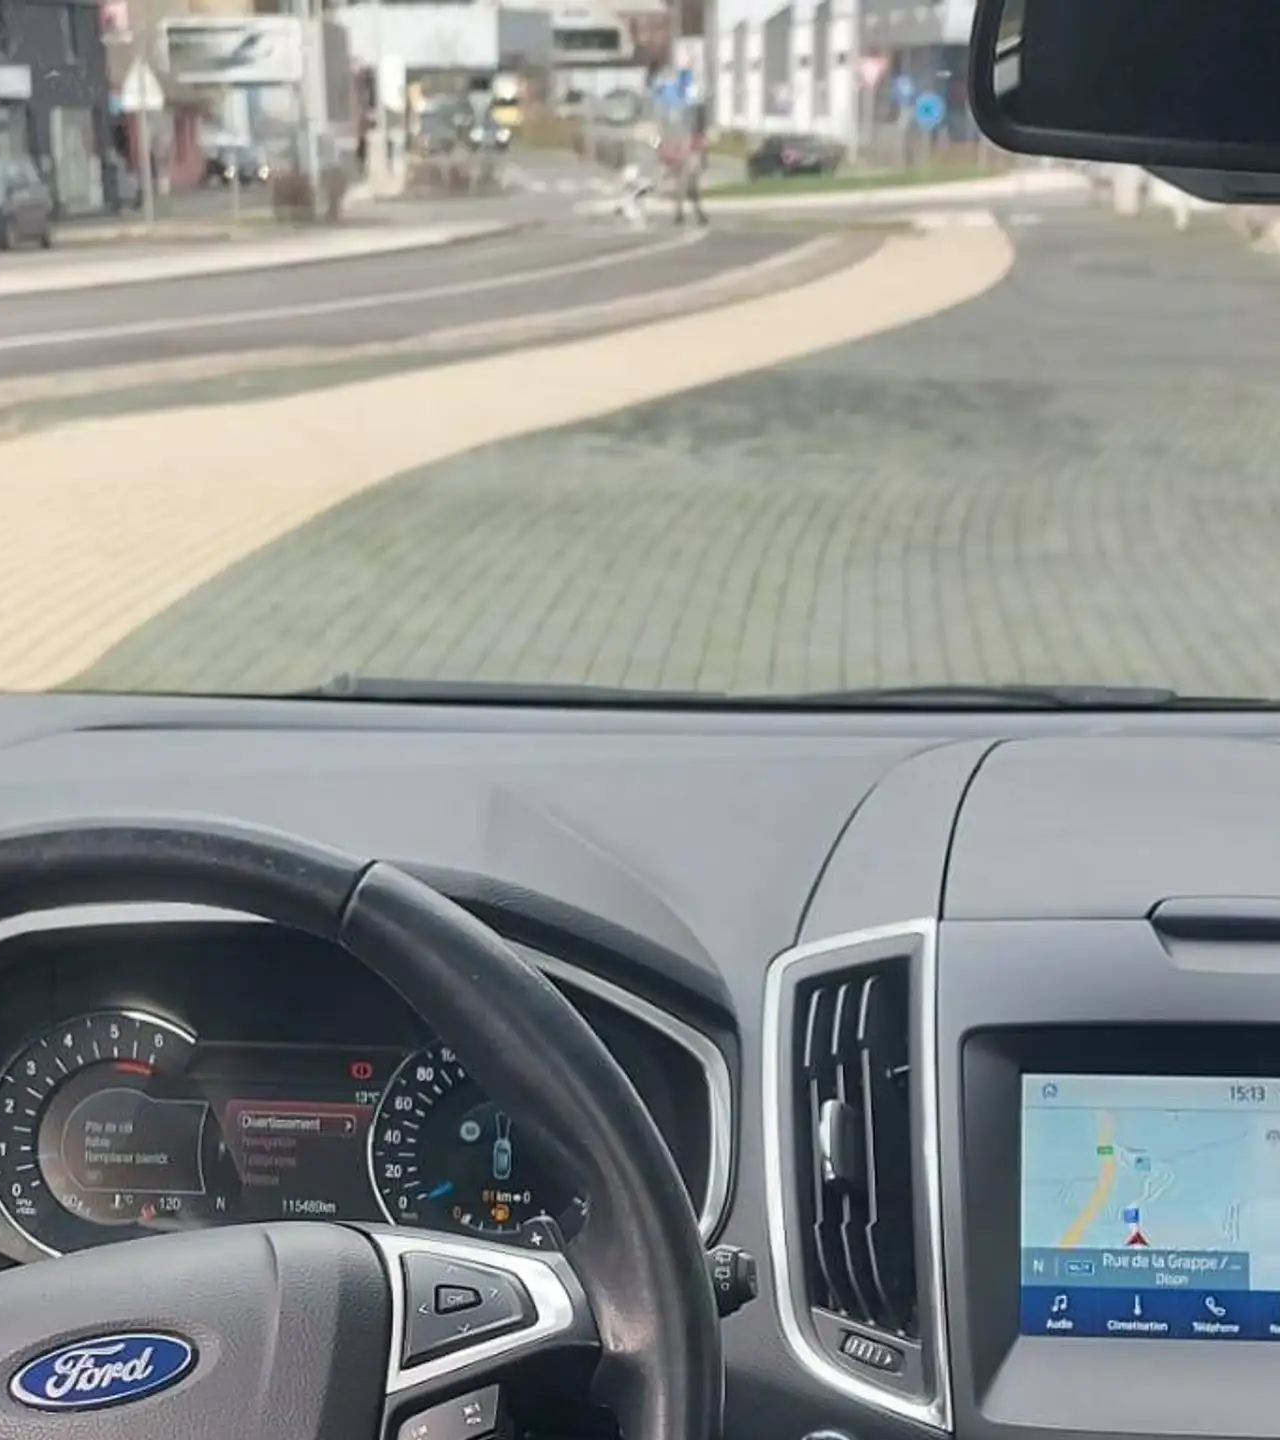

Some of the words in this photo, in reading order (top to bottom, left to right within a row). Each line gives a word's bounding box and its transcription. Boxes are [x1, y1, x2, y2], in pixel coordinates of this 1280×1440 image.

[110, 1025, 119, 1039] 5
[63, 1033, 73, 1047] 4
[154, 1033, 164, 1047] 6
[26, 1061, 36, 1075] 3
[416, 1066, 434, 1082] 80
[1230, 1085, 1266, 1101] 15:13
[5, 1099, 14, 1114] 2
[394, 1096, 413, 1111] 60
[383, 1129, 402, 1145] 40
[384, 1164, 402, 1178] 20
[12, 1183, 21, 1198] 0
[398, 1196, 408, 1209] 0
[1102, 1252, 1129, 1269] Rue
[1131, 1253, 1151, 1270] de
[1152, 1253, 1165, 1270] la
[1168, 1254, 1218, 1275] Grappe
[1046, 1318, 1074, 1331] Audio
[44, 1342, 154, 1398] Ford
